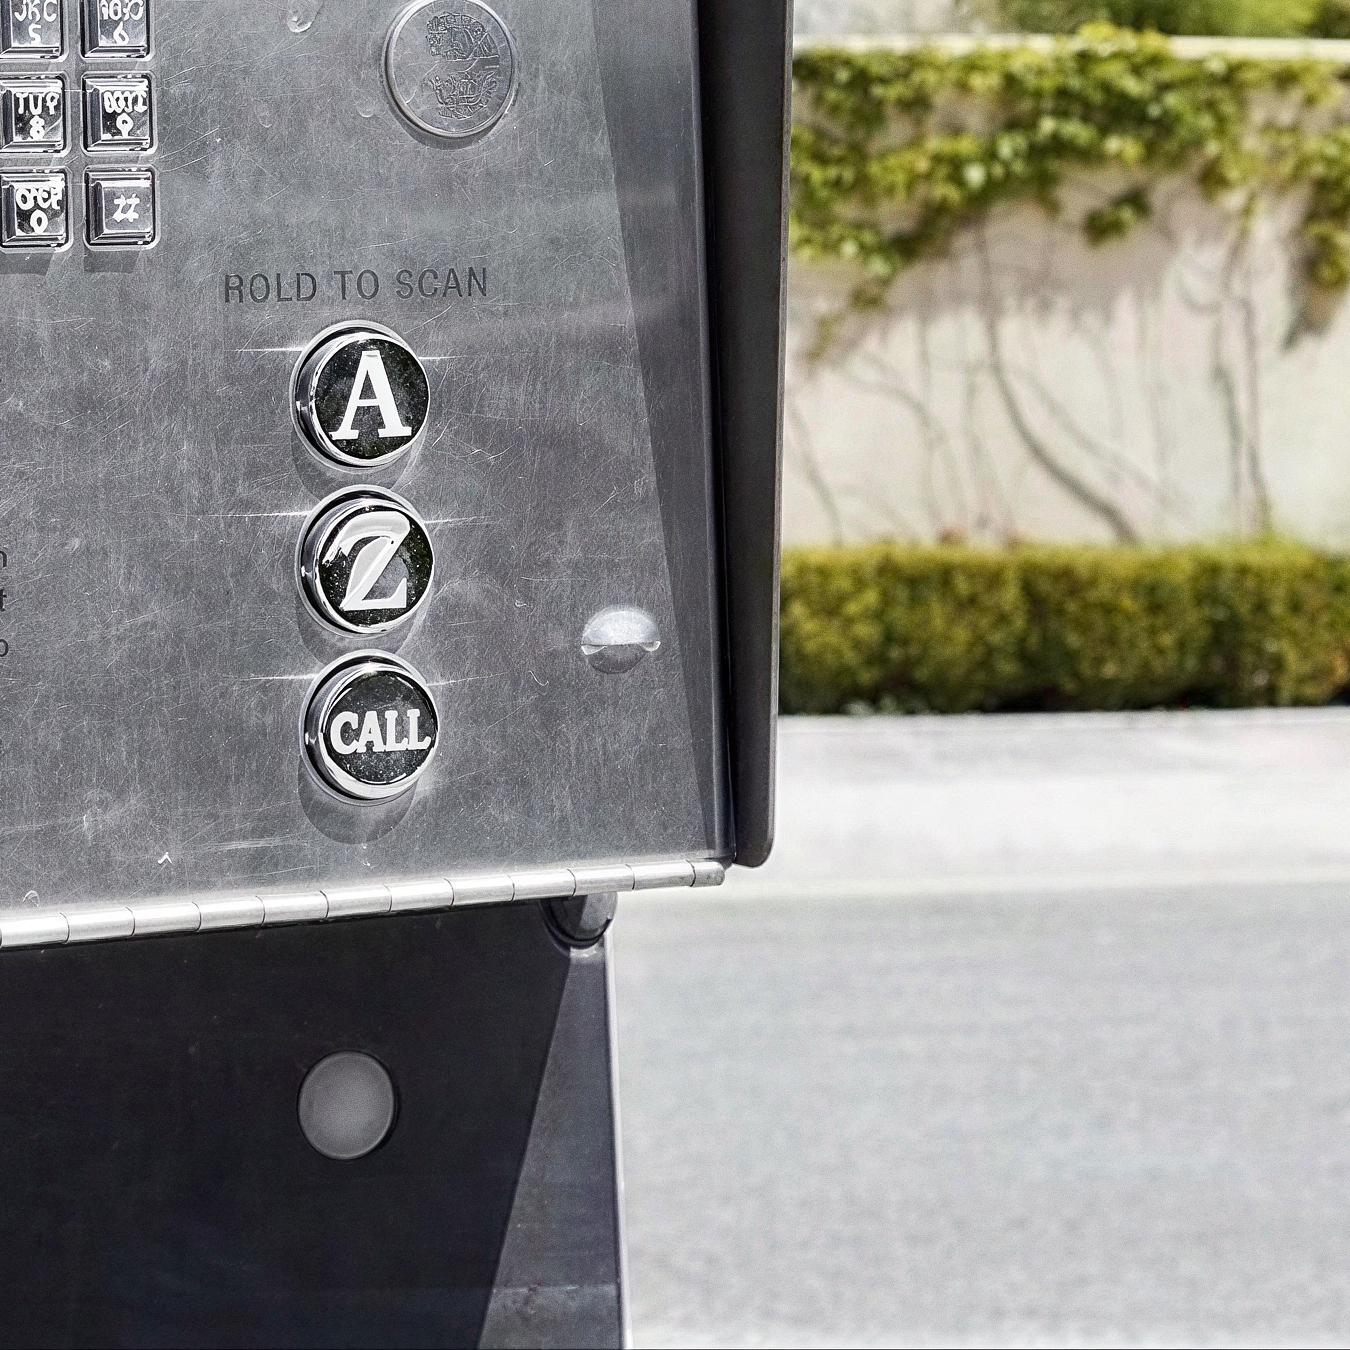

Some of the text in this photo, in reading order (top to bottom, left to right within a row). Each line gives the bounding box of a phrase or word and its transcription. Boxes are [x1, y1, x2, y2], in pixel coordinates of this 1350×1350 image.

[28, 23, 42, 46] 5
[28, 115, 46, 140] 8
[334, 269, 380, 301] TO
[395, 266, 487, 299] SCAN
[328, 349, 413, 441] A
[329, 708, 432, 755] CALL
